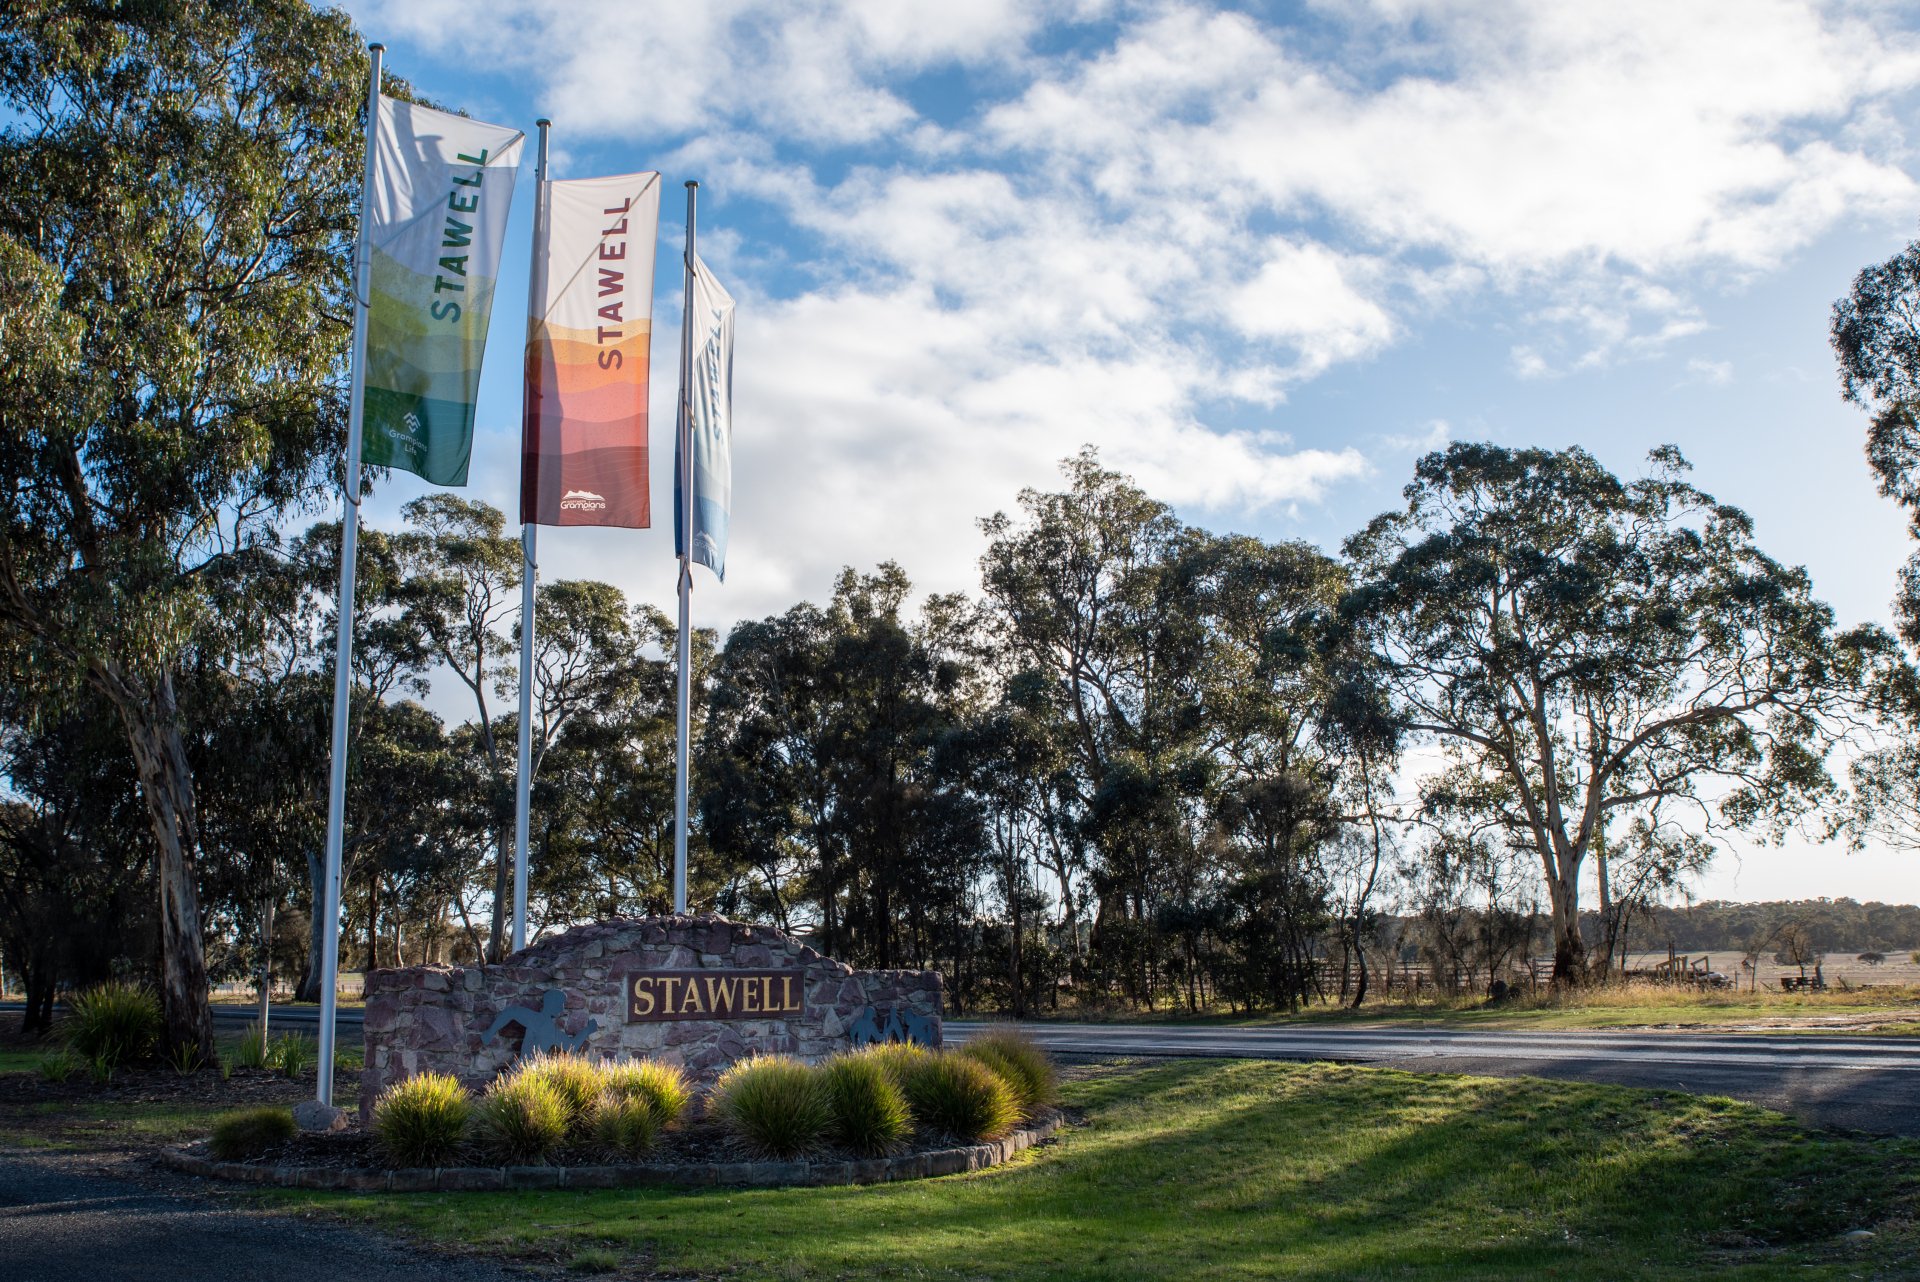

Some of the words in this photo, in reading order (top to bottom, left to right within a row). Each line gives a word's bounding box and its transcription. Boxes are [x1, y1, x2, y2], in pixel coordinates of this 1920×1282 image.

[430, 148, 489, 323] STAWELL
[598, 197, 632, 371] STAWELL
[388, 429, 428, 452] Grampians
[404, 444, 418, 456] Life
[560, 500, 606, 511] Grampians
[634, 976, 800, 1016] STAWELL
